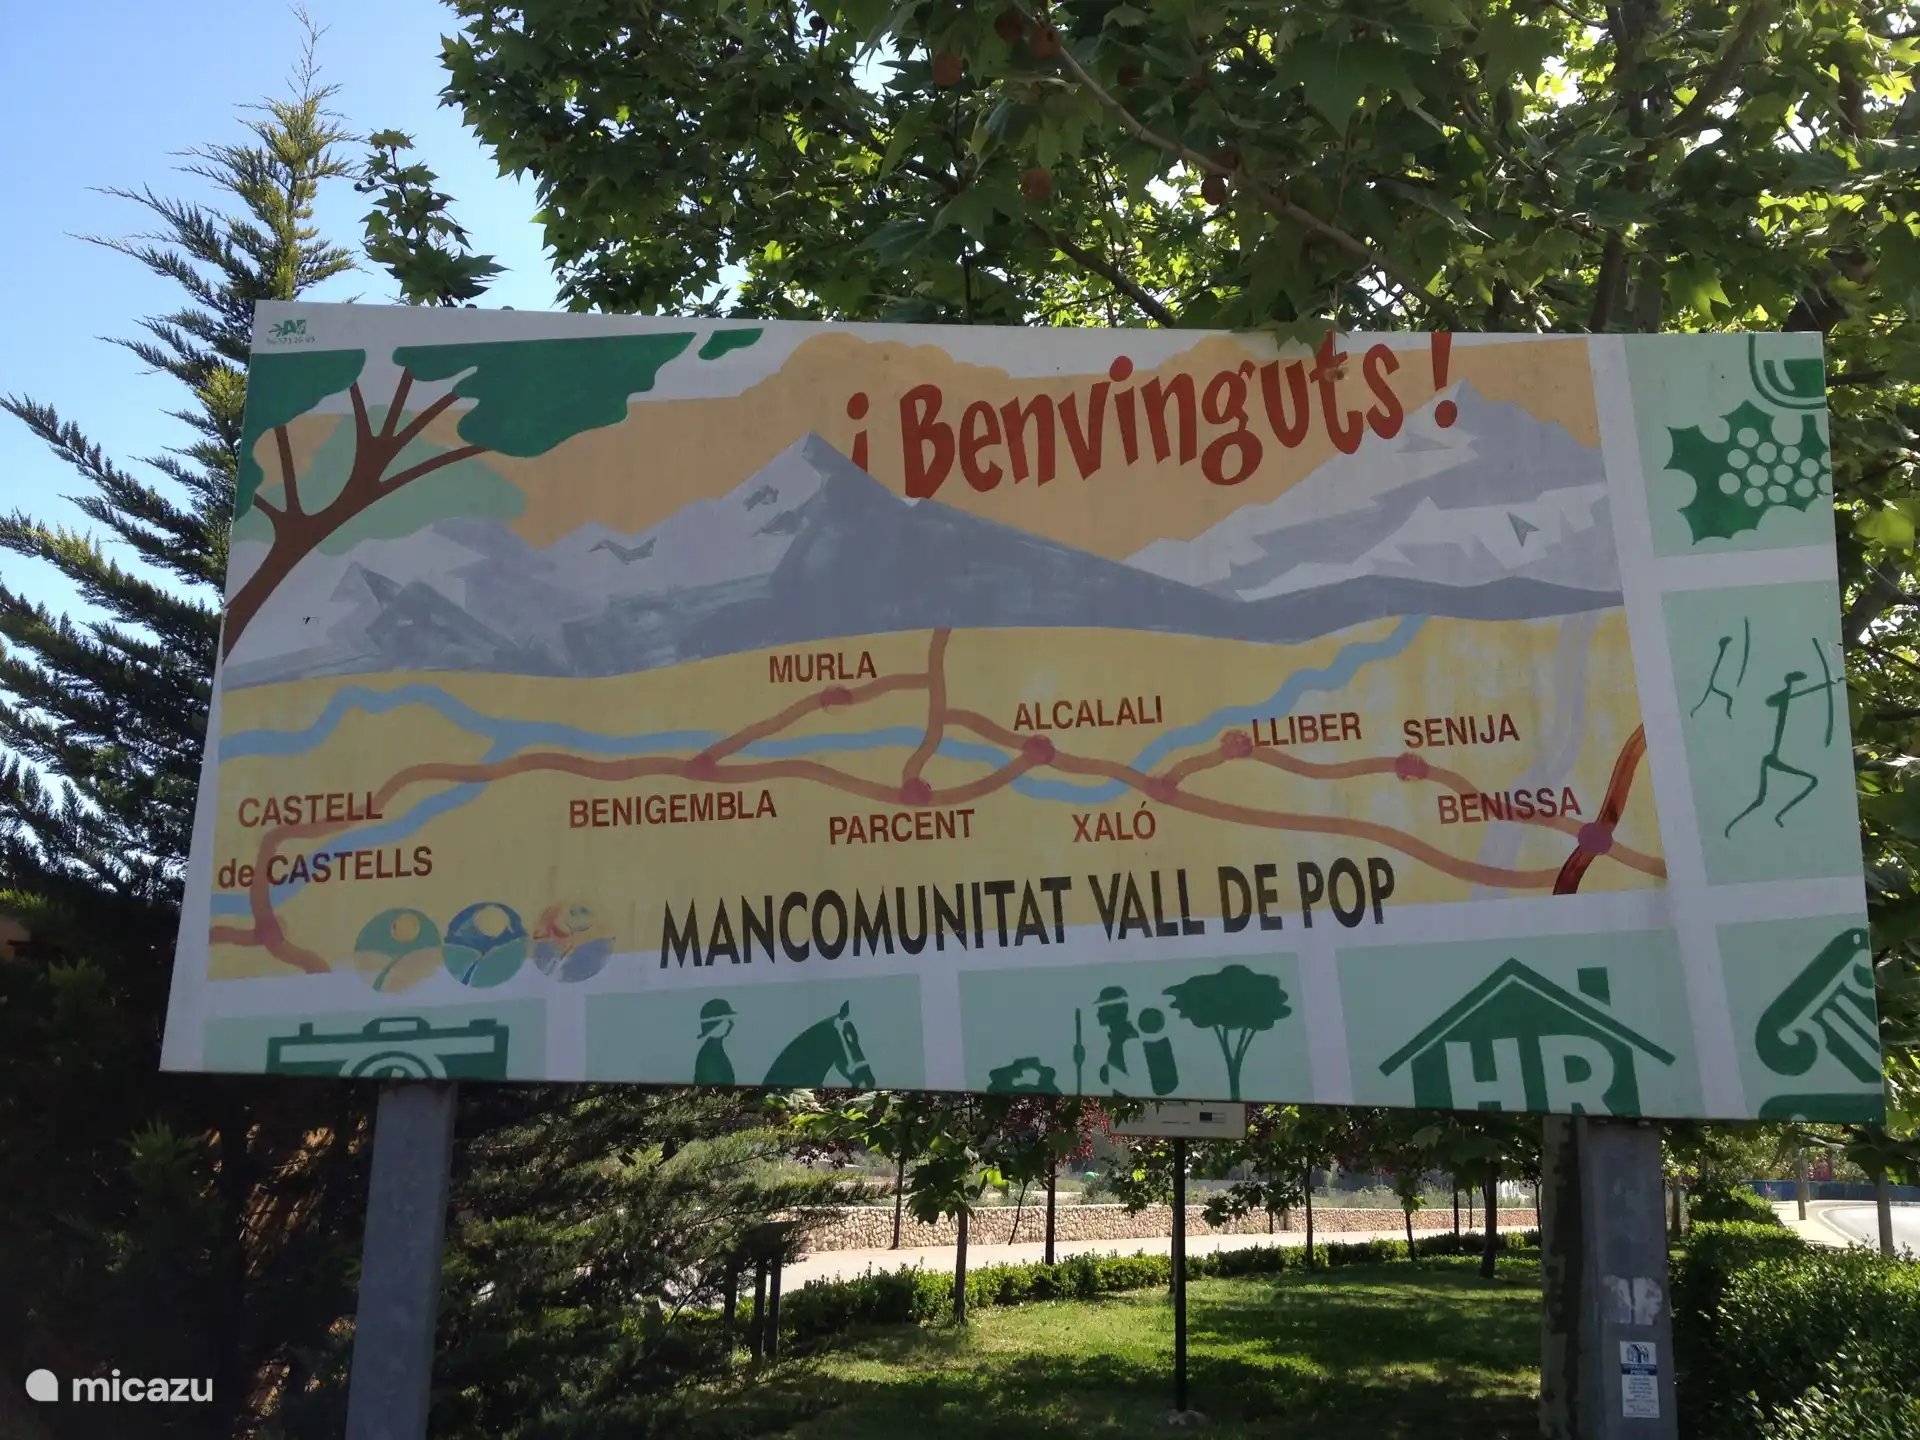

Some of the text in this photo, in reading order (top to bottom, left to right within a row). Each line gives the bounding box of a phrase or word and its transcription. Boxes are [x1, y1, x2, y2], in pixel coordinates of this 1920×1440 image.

[769, 651, 878, 684] MURLA
[1013, 695, 1164, 732] ALCALALI
[1252, 711, 1363, 748] LLIBER
[1403, 713, 1521, 749] SENIJA
[238, 791, 384, 828] CASTELL
[569, 789, 778, 830] BENIGEMBLA
[1072, 801, 1157, 843] XALÓ
[1437, 786, 1583, 825] BENISSA
[829, 808, 976, 845] PARCENT
[217, 846, 434, 889] de CASTELLS
[660, 857, 1397, 970] MANCOMUNITAT VALL DE POP
[1445, 1034, 1616, 1115] HR
